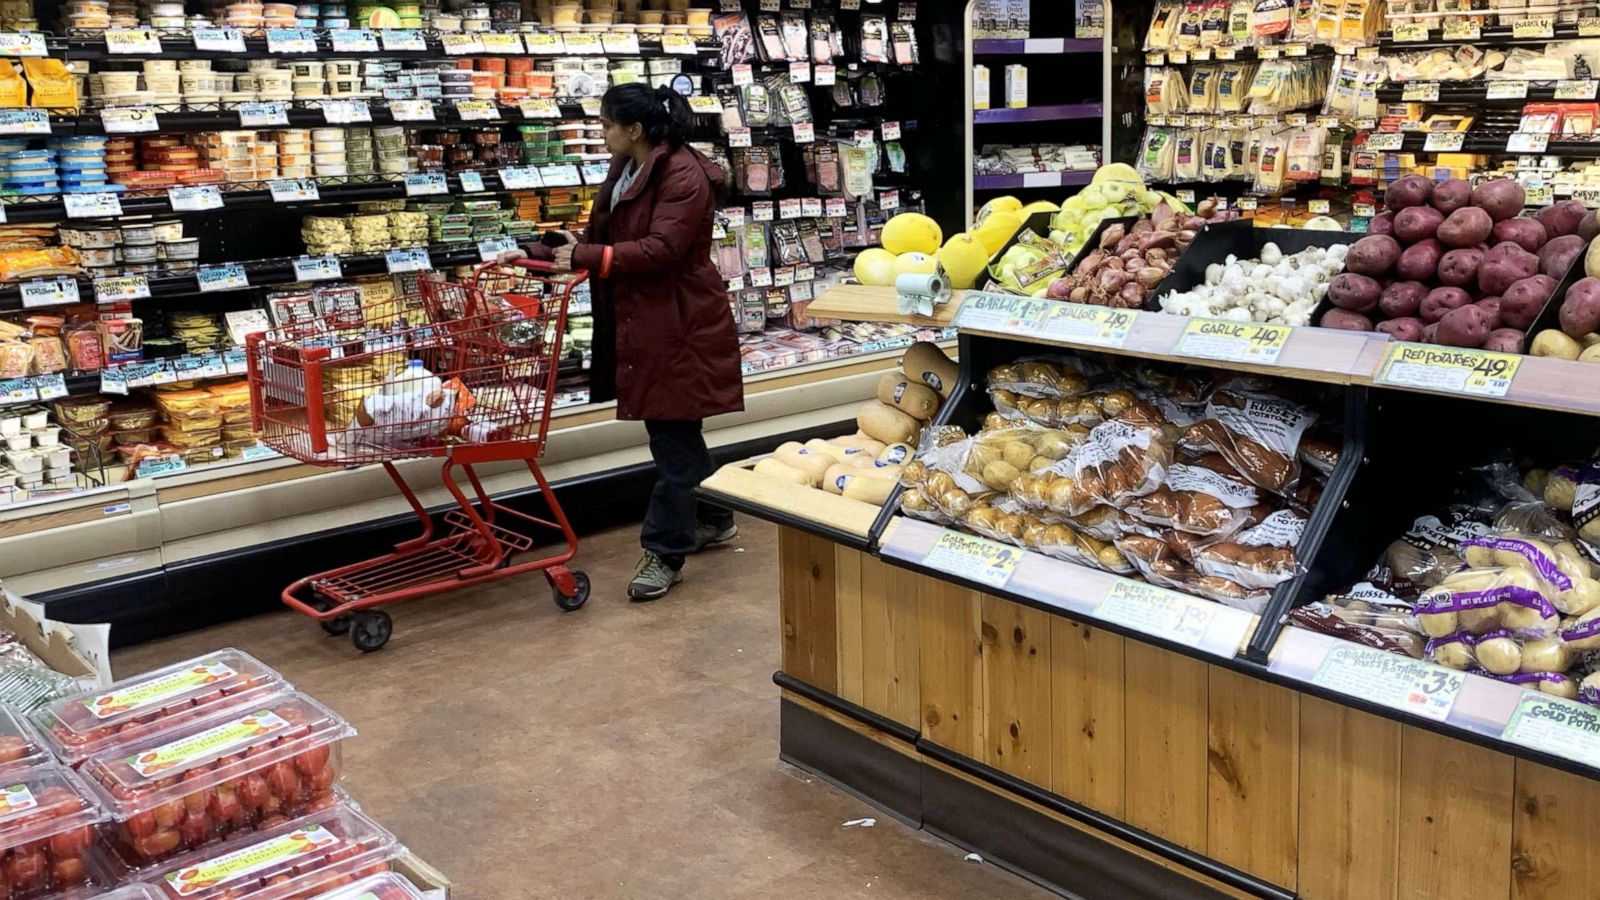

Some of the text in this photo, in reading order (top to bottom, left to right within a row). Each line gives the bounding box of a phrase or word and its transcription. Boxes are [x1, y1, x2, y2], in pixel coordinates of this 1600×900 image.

[975, 296, 1019, 313] GARLIC
[1058, 307, 1128, 329] SHALLOTS 49
[1200, 323, 1278, 346] GARLIC 49
[1402, 348, 1508, 377] RED POTATOES 49
[1248, 410, 1297, 428] POTATOES
[1250, 401, 1301, 423] RUSSET
[942, 533, 964, 545] GOLD
[1115, 582, 1154, 595] RUSSET
[1353, 590, 1390, 600] RUSSET
[1336, 649, 1385, 662] ORGANIC
[1353, 657, 1397, 669] RUSSET
[1532, 705, 1567, 723] GOLD
